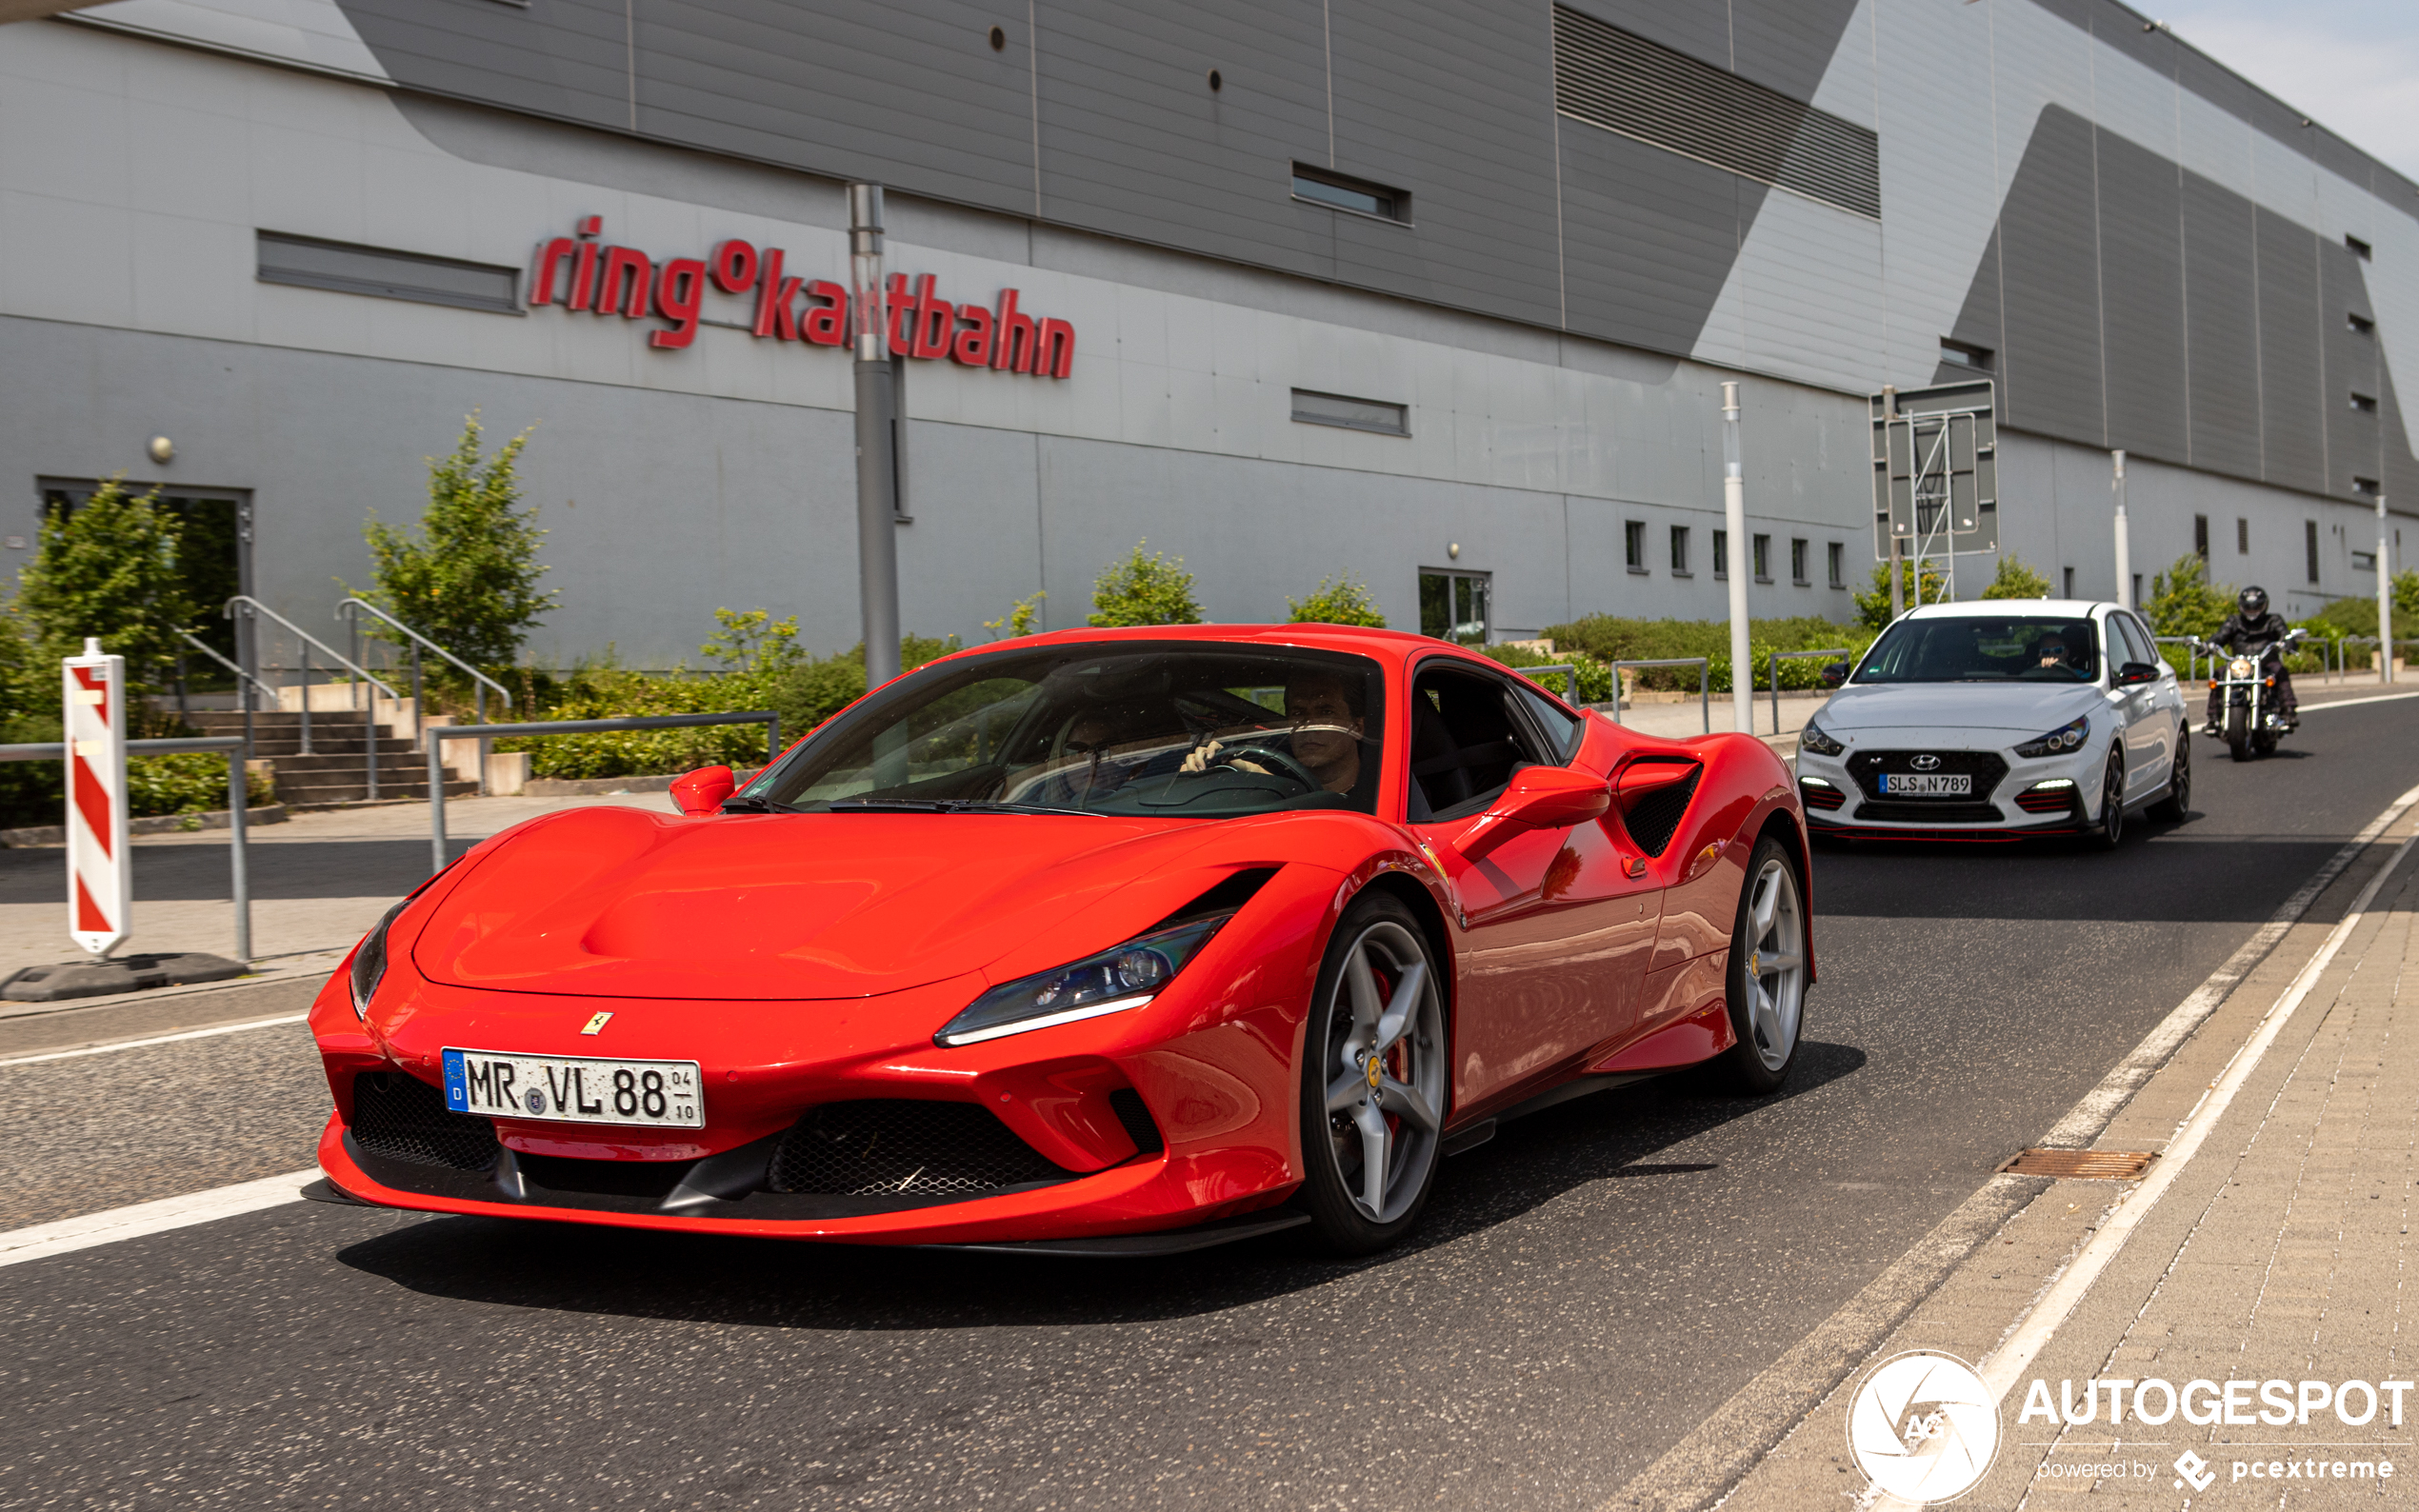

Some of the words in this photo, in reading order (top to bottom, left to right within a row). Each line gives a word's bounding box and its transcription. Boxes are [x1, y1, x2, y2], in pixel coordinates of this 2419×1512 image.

[1888, 776, 1917, 791] SLS
[1928, 777, 1938, 791] N
[1941, 777, 1969, 791] 789
[671, 1071, 691, 1085] 04
[452, 1086, 463, 1101] D
[467, 1059, 520, 1109] MR
[547, 1064, 602, 1115] VL
[613, 1068, 666, 1118] 88
[676, 1104, 693, 1119] 10
